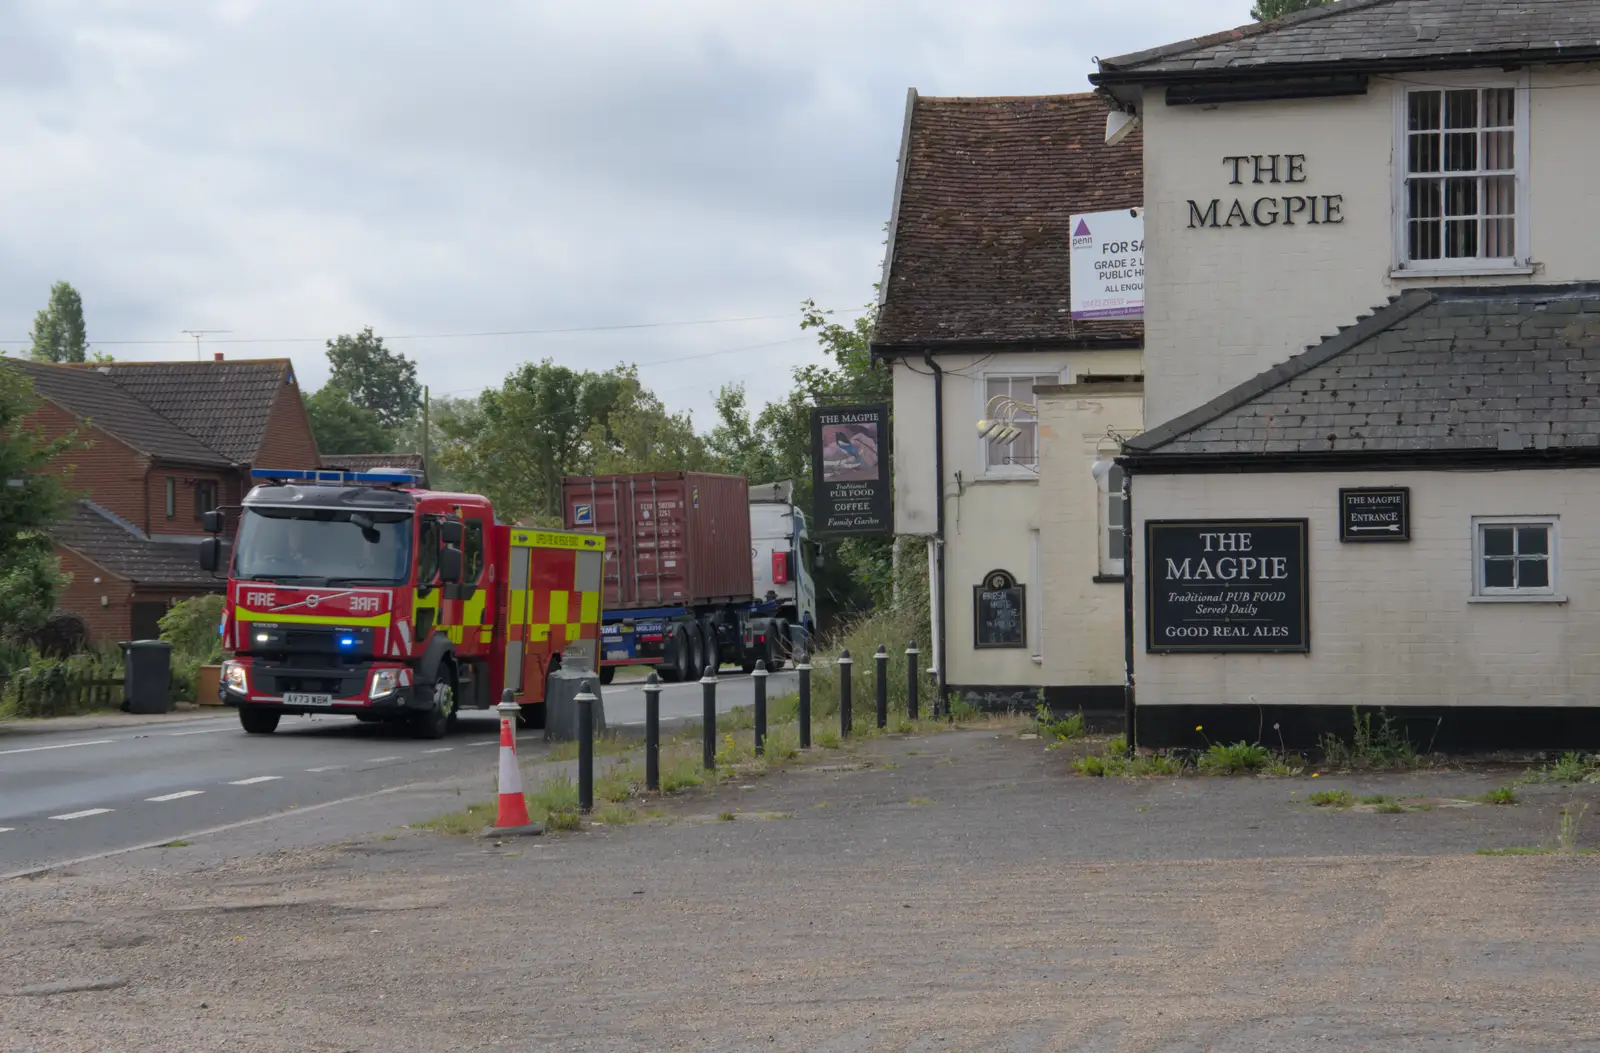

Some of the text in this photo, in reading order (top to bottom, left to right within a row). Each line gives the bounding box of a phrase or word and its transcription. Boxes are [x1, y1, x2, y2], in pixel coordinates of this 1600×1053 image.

[1222, 154, 1307, 185] THE
[1186, 194, 1345, 228] MAGPIE
[1072, 237, 1093, 246] penn
[1102, 241, 1128, 254] FOR
[1094, 260, 1127, 270] GRADE
[1130, 258, 1136, 267] 2
[1099, 269, 1133, 280] PUBLIC
[1105, 283, 1144, 293] ALL ENQU
[820, 413, 879, 424] THE MAGPIE
[836, 482, 868, 490] Traditional
[849, 488, 875, 497] FOOD
[1347, 496, 1401, 504] THE MAGPIE
[834, 502, 870, 511] COFFEE
[828, 516, 880, 527] Family Garden
[1351, 512, 1398, 522] ENTRANCE
[1200, 532, 1253, 552] THE
[1165, 556, 1288, 580] MAGPIE
[246, 592, 276, 607] FIRE
[1168, 591, 1286, 602] Traditional PUB FOOD
[1195, 603, 1258, 616] Served Daily
[1165, 625, 1289, 637] GOOD REAL ALES
